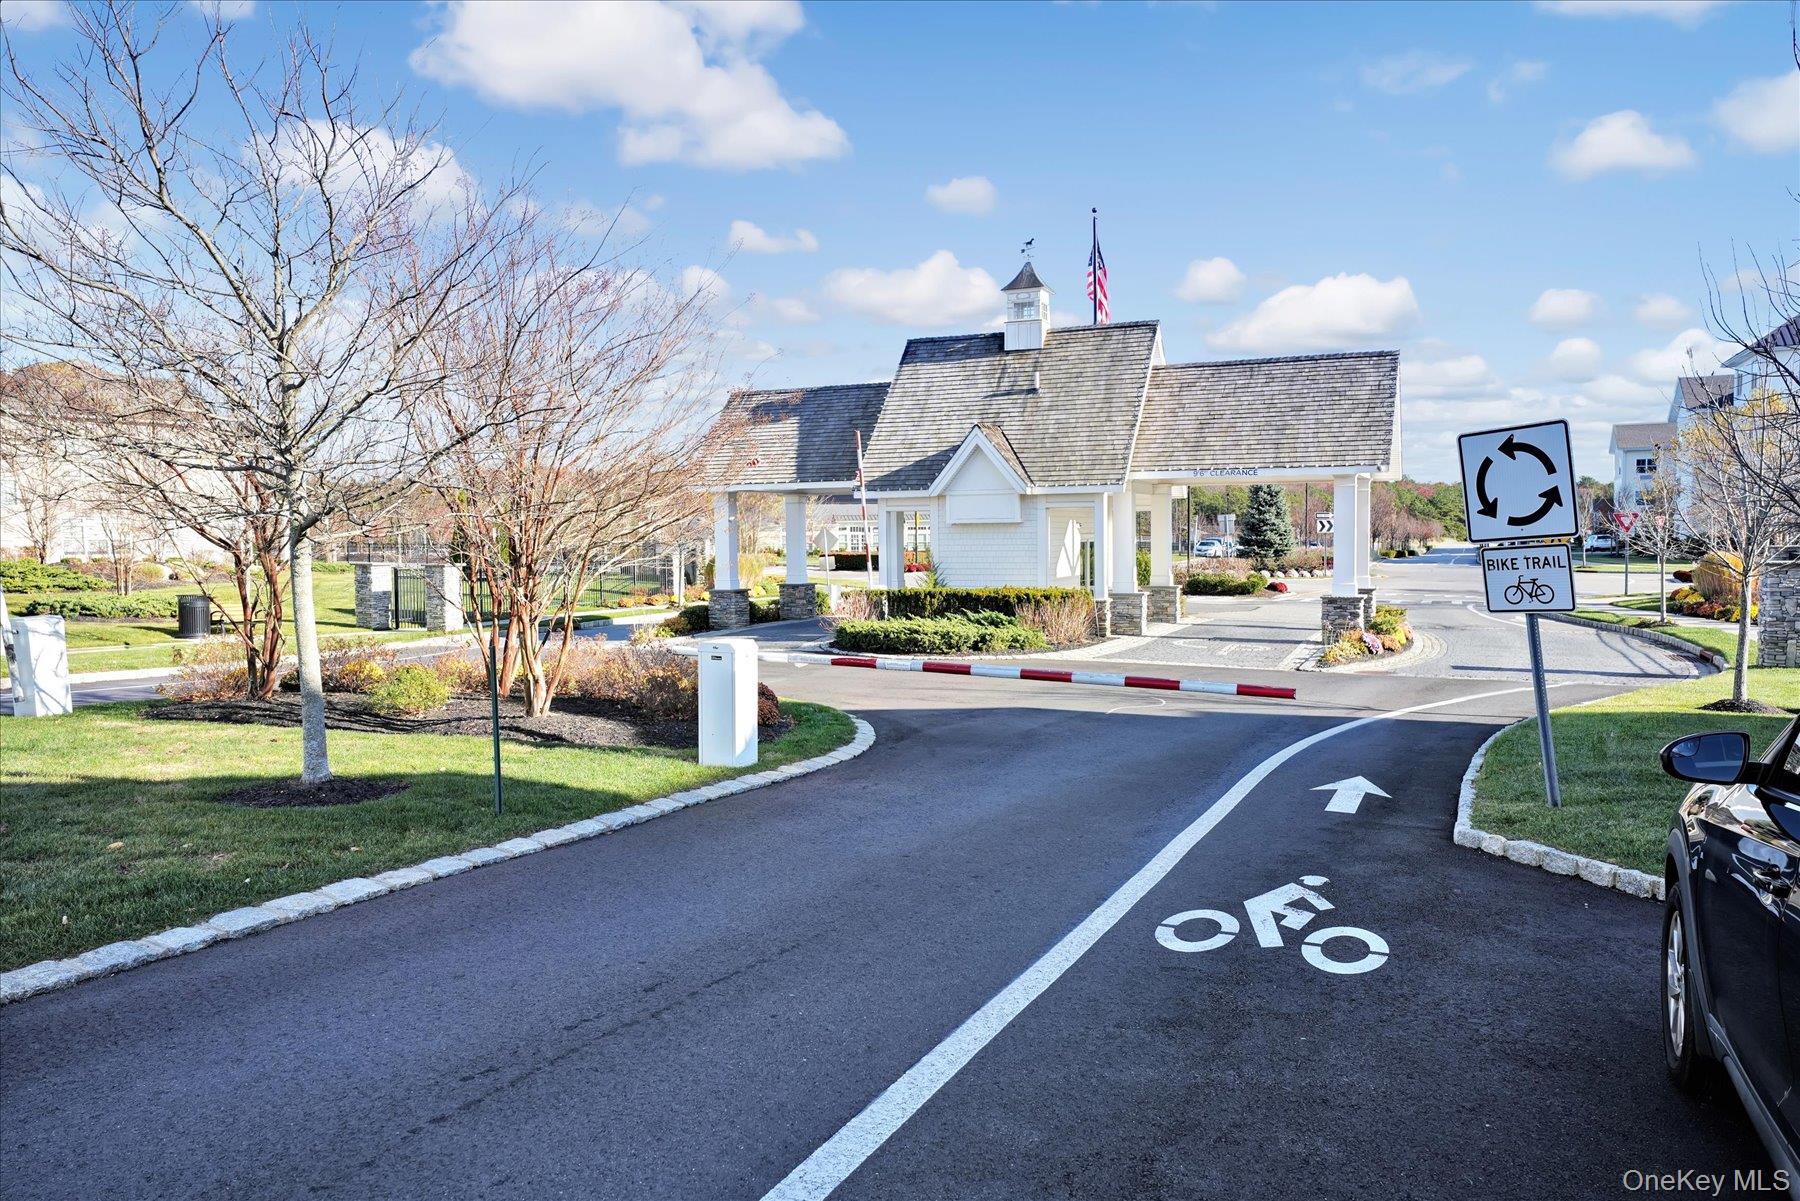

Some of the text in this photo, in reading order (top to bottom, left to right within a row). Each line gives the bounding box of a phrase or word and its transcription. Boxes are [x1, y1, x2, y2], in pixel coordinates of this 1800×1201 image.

[1210, 469, 1258, 477] CLEARANCE
[1486, 555, 1566, 571] BIKE TRAIL
